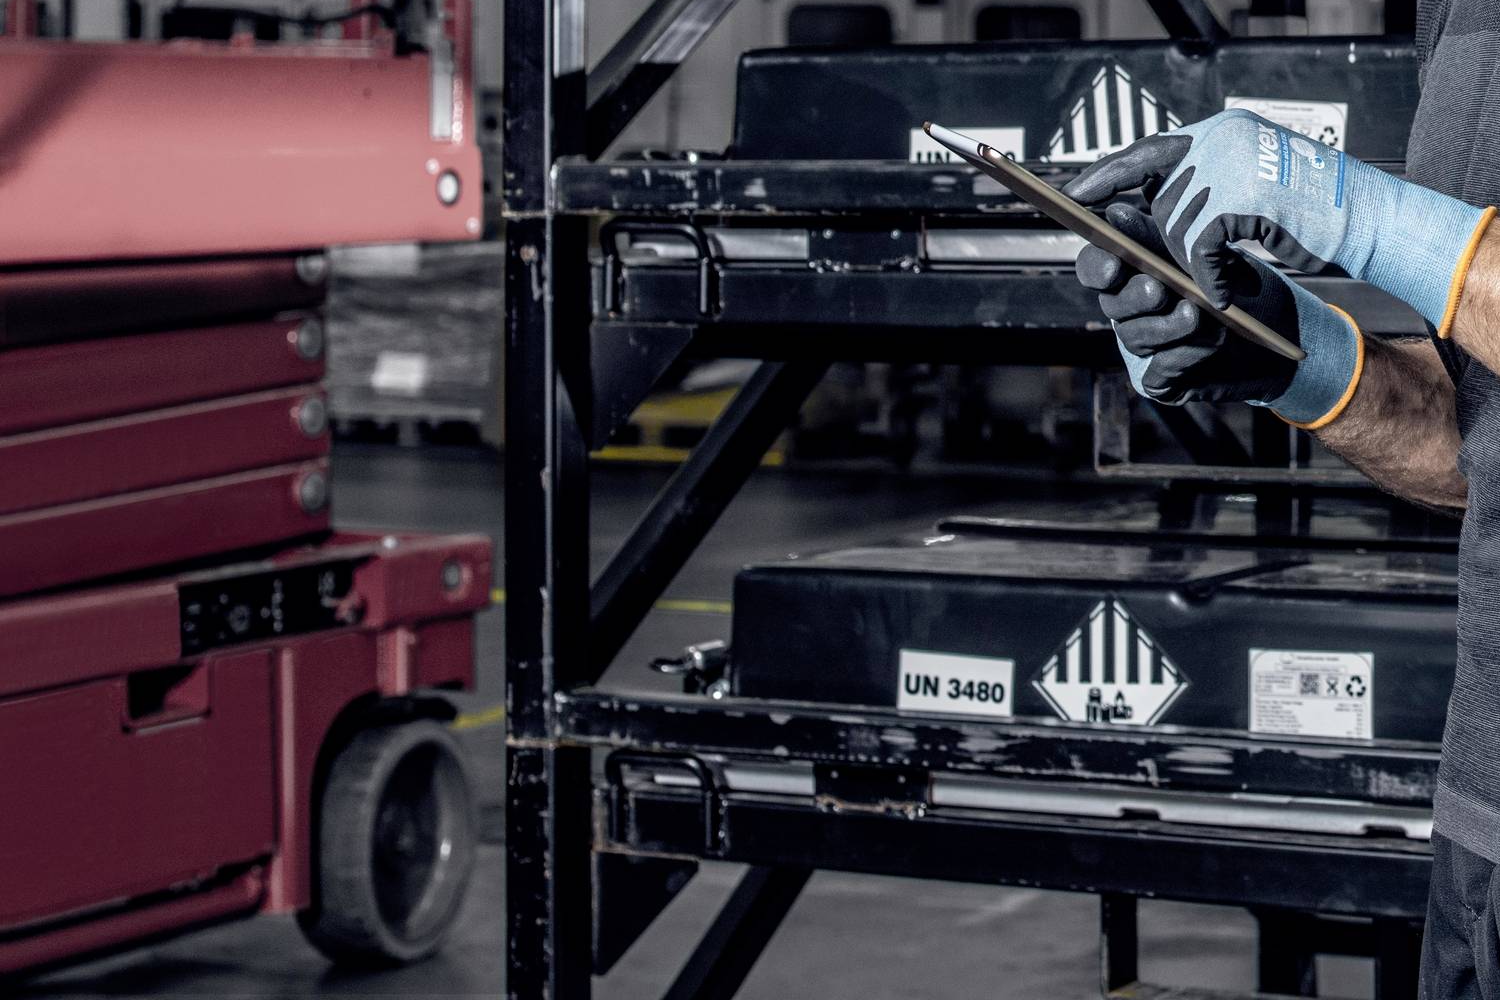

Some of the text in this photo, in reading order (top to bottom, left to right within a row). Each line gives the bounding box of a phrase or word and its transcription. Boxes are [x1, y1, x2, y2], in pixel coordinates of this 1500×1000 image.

[1258, 122, 1279, 181] uvex
[905, 673, 1005, 704] UN 3480
